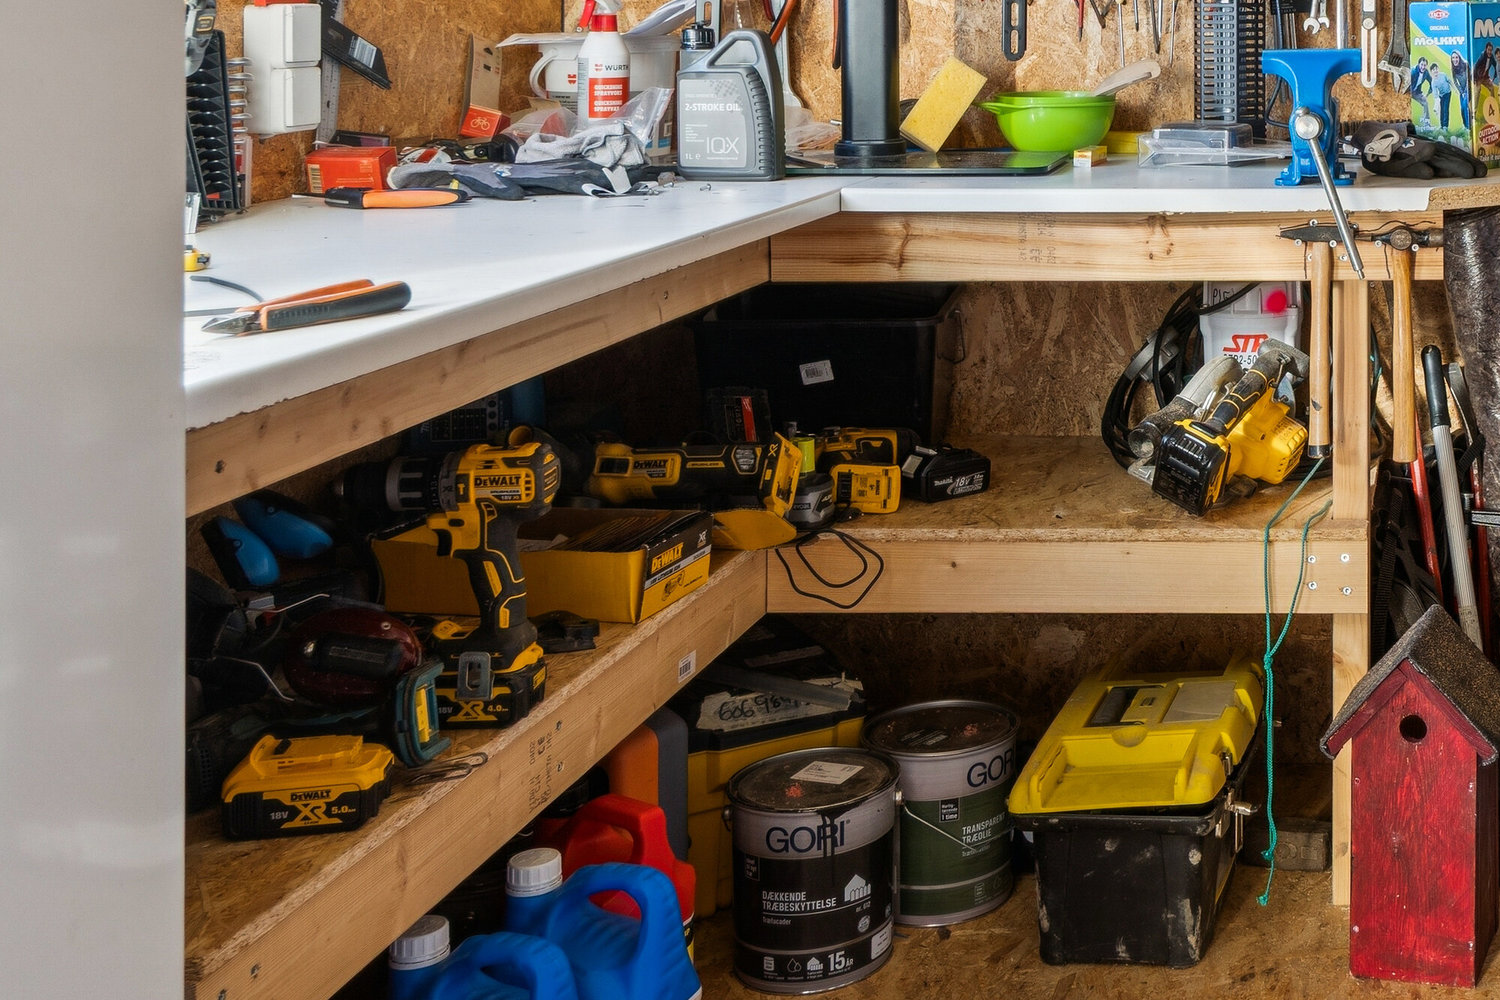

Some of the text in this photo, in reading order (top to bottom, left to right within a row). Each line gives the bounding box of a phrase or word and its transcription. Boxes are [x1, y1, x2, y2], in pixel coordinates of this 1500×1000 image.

[1414, 36, 1465, 46] MÖLKKY
[684, 103, 741, 112] 2-STROKE OIL
[633, 460, 668, 469] DEWALT
[474, 476, 522, 486] DEWALT
[652, 543, 684, 574] DEWALT
[719, 700, 755, 720] 606
[291, 790, 331, 802] DEWALT
[270, 811, 288, 820] 18V
[962, 812, 1005, 835] TRANSPARENT
[766, 821, 844, 853] GORI
[962, 829, 992, 844] TRÆOLIE
[762, 891, 806, 901] DÆKKENDE
[762, 898, 837, 911] TRÆBESKYTTELSE
[828, 951, 854, 971] 15 ÅR
